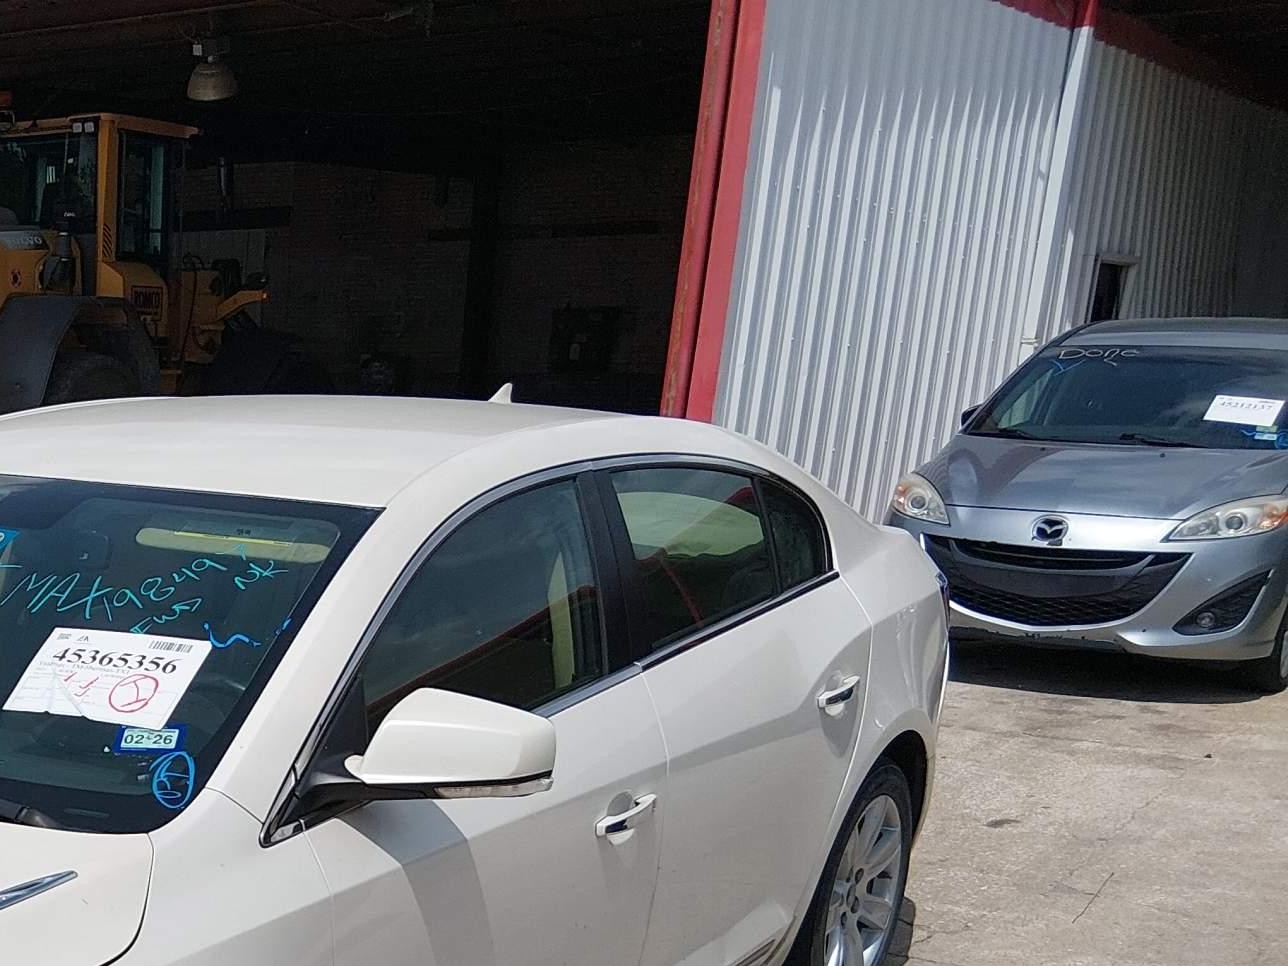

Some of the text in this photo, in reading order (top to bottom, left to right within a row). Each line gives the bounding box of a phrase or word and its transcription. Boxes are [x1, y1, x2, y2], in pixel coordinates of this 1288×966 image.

[53, 647, 184, 674] 45365356
[124, 734, 173, 745] 02 26
